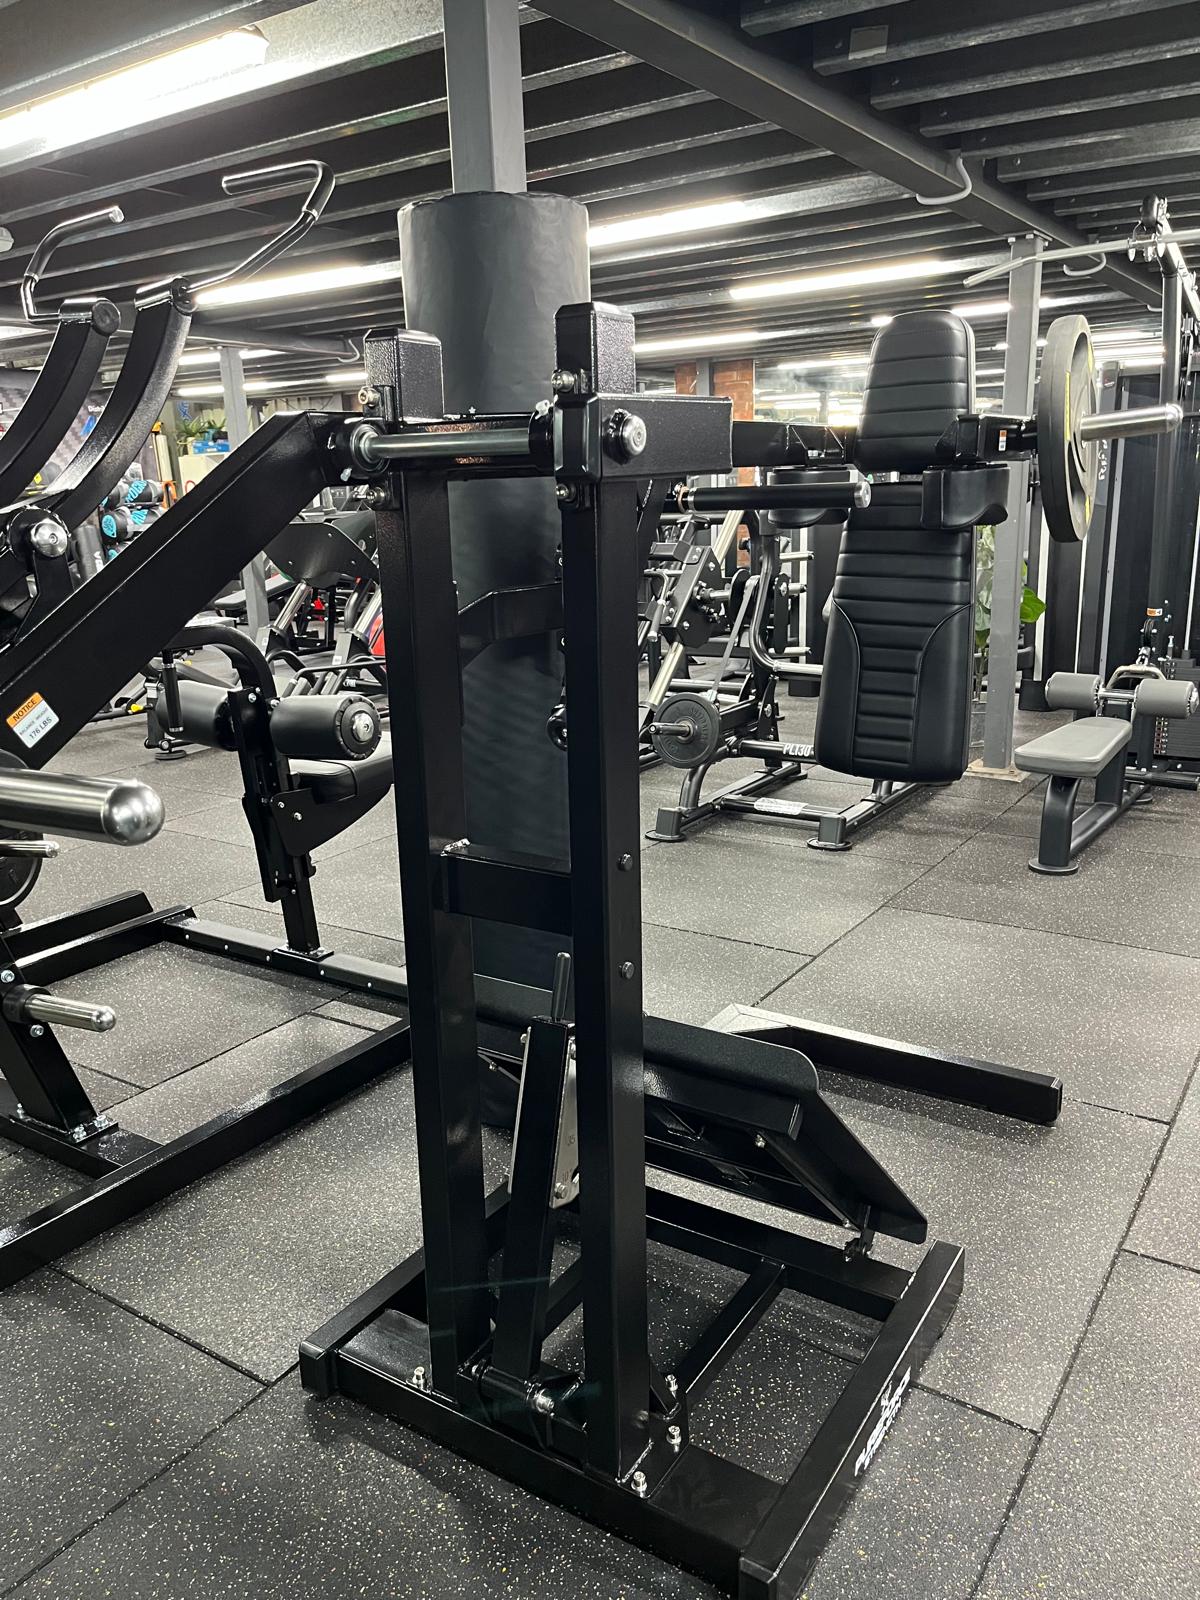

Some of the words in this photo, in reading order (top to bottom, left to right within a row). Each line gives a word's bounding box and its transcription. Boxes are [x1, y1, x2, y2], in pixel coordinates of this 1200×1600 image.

[13, 698, 37, 721] NOTICE
[29, 727, 41, 740] 176
[40, 716, 53, 730] LBS
